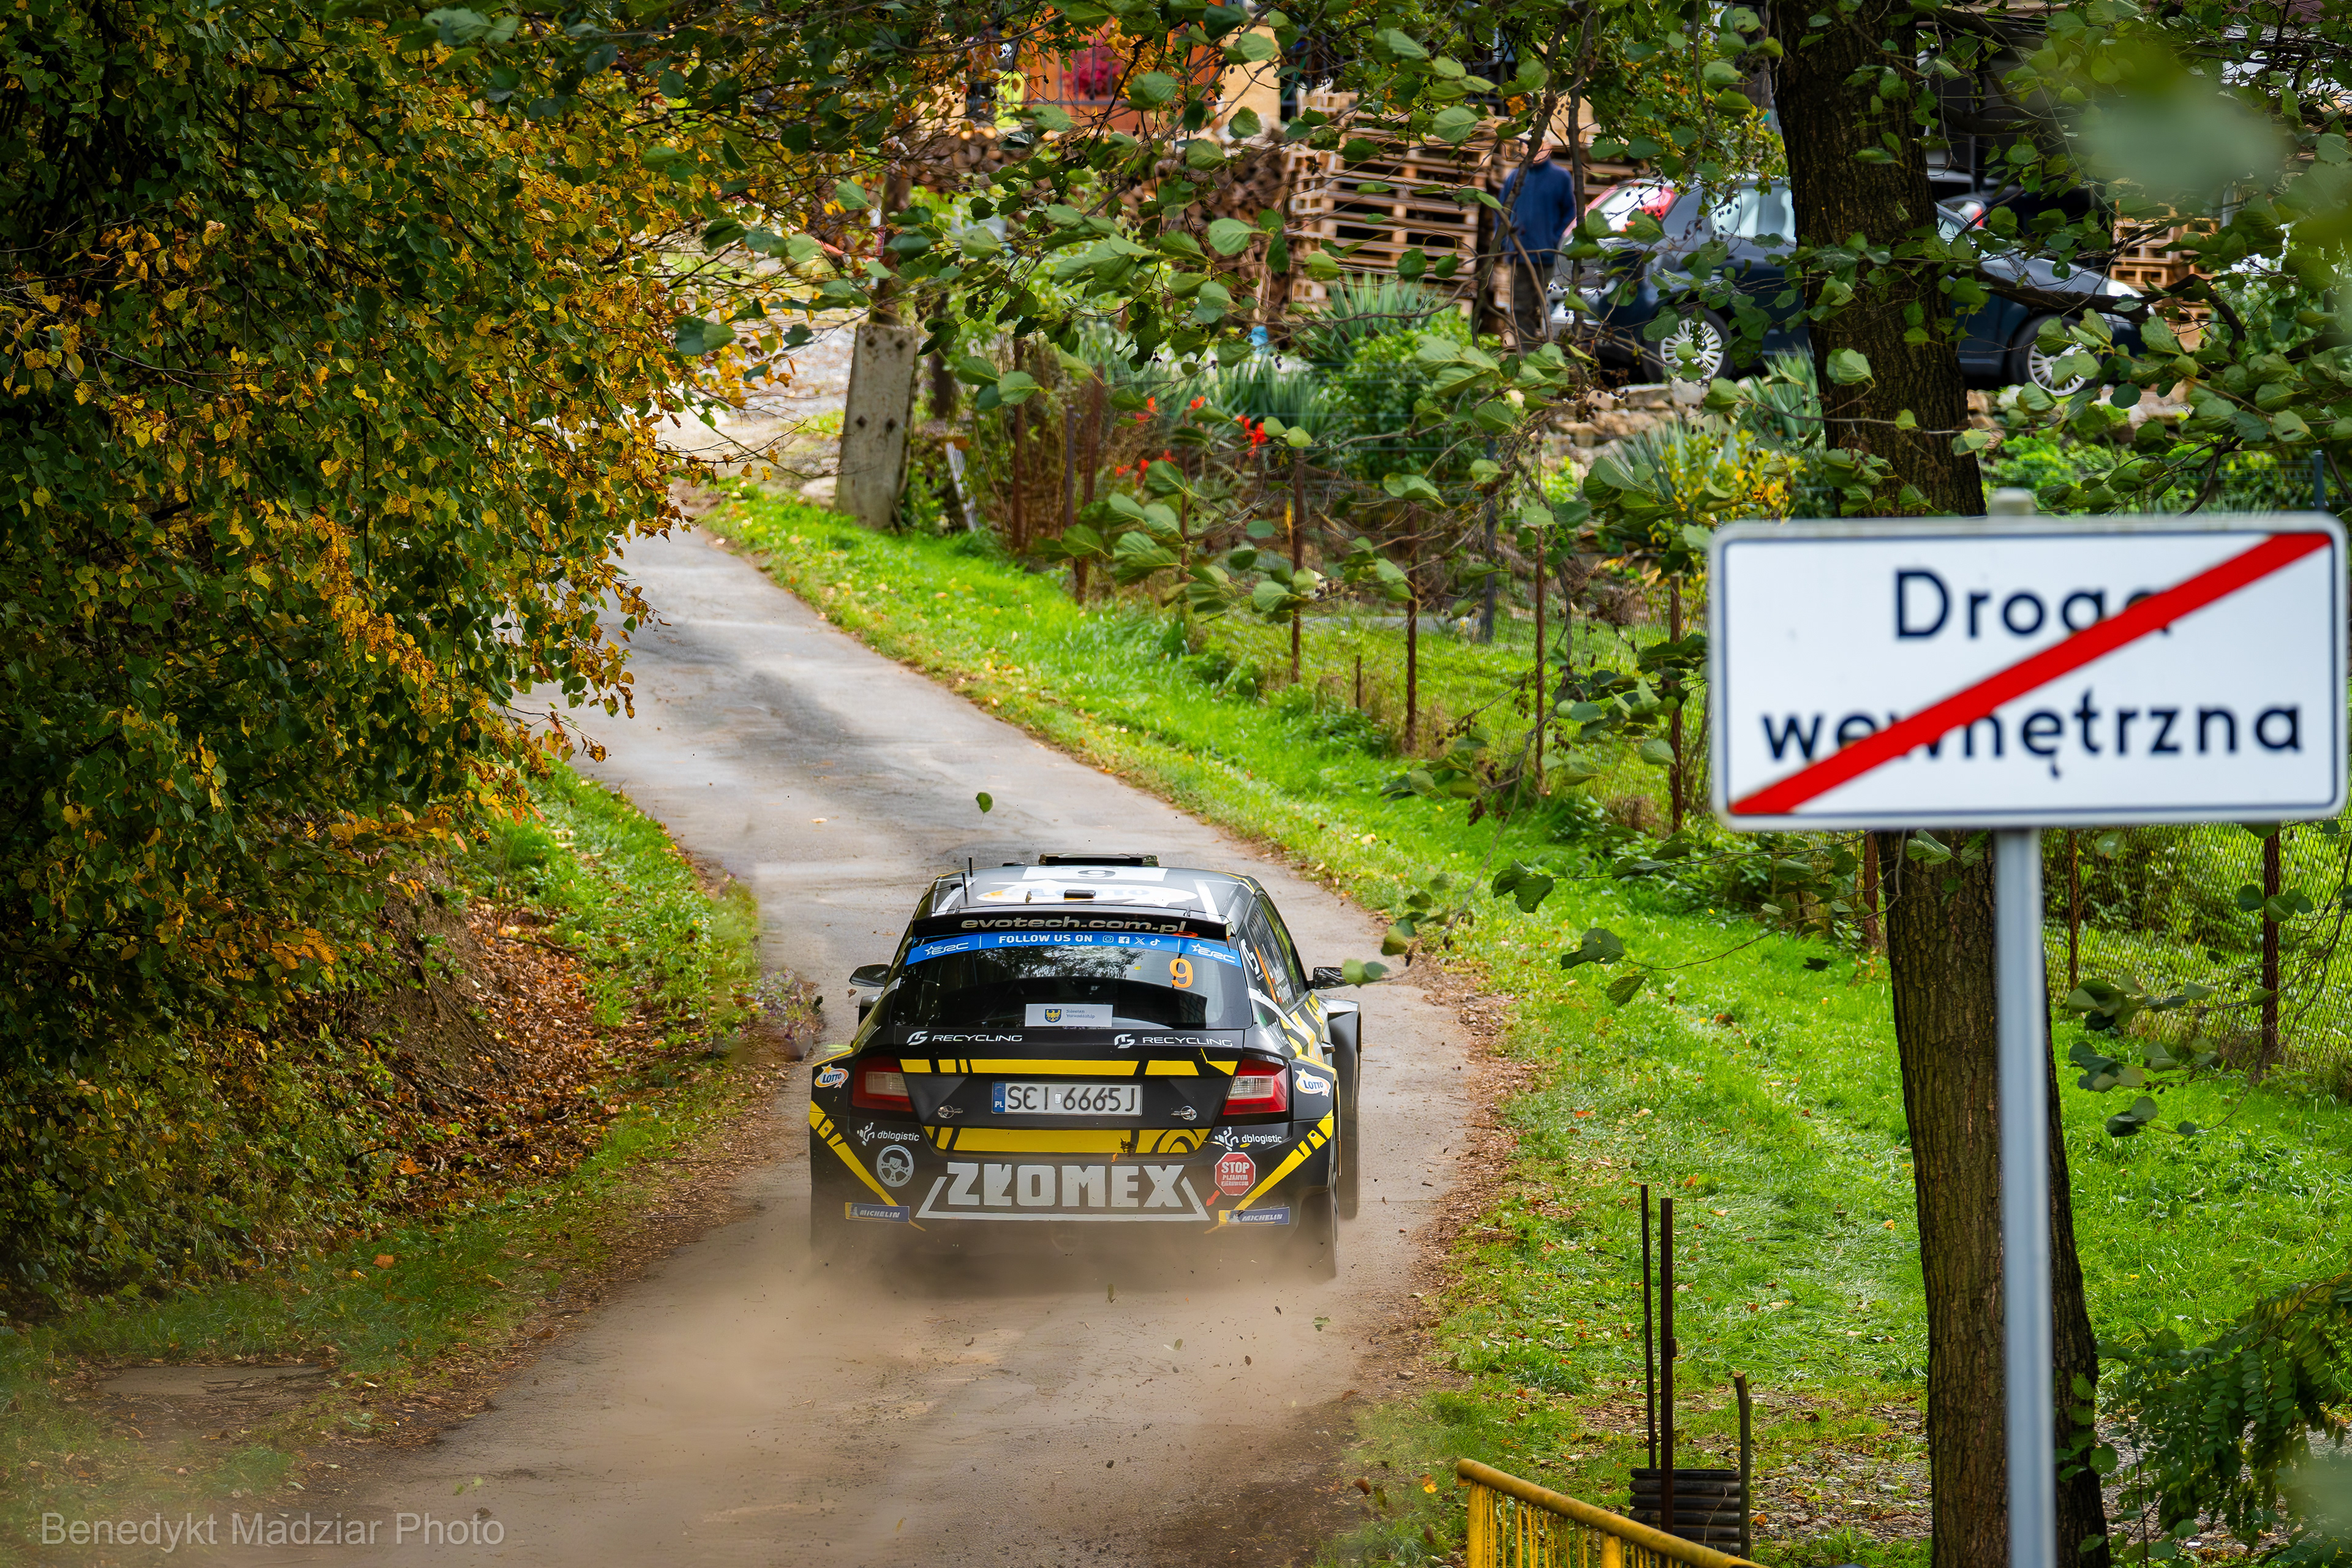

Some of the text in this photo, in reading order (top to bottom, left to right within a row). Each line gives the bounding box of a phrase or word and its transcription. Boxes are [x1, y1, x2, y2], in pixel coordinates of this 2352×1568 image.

[1762, 687, 2303, 779] wenętrzna
[960, 916, 1186, 933] evotech.com.pl
[998, 934, 1093, 944] FOLLOW US ON
[930, 942, 969, 956] ERC
[1197, 946, 1236, 964] ERC
[1169, 957, 1194, 989] 9
[932, 1034, 1023, 1042] RECYCLING
[1142, 1036, 1234, 1047] RECYCLING
[821, 1072, 842, 1084] LOTTO
[1303, 1079, 1324, 1090] LOTTO
[1063, 1087, 1136, 1112] 6665J
[876, 1129, 920, 1142] dblogistic
[1241, 1133, 1283, 1145] dblogistic
[1221, 1161, 1250, 1174] STOP
[859, 1209, 900, 1218] MICHELIN
[1242, 1213, 1283, 1222] MICHELIN
